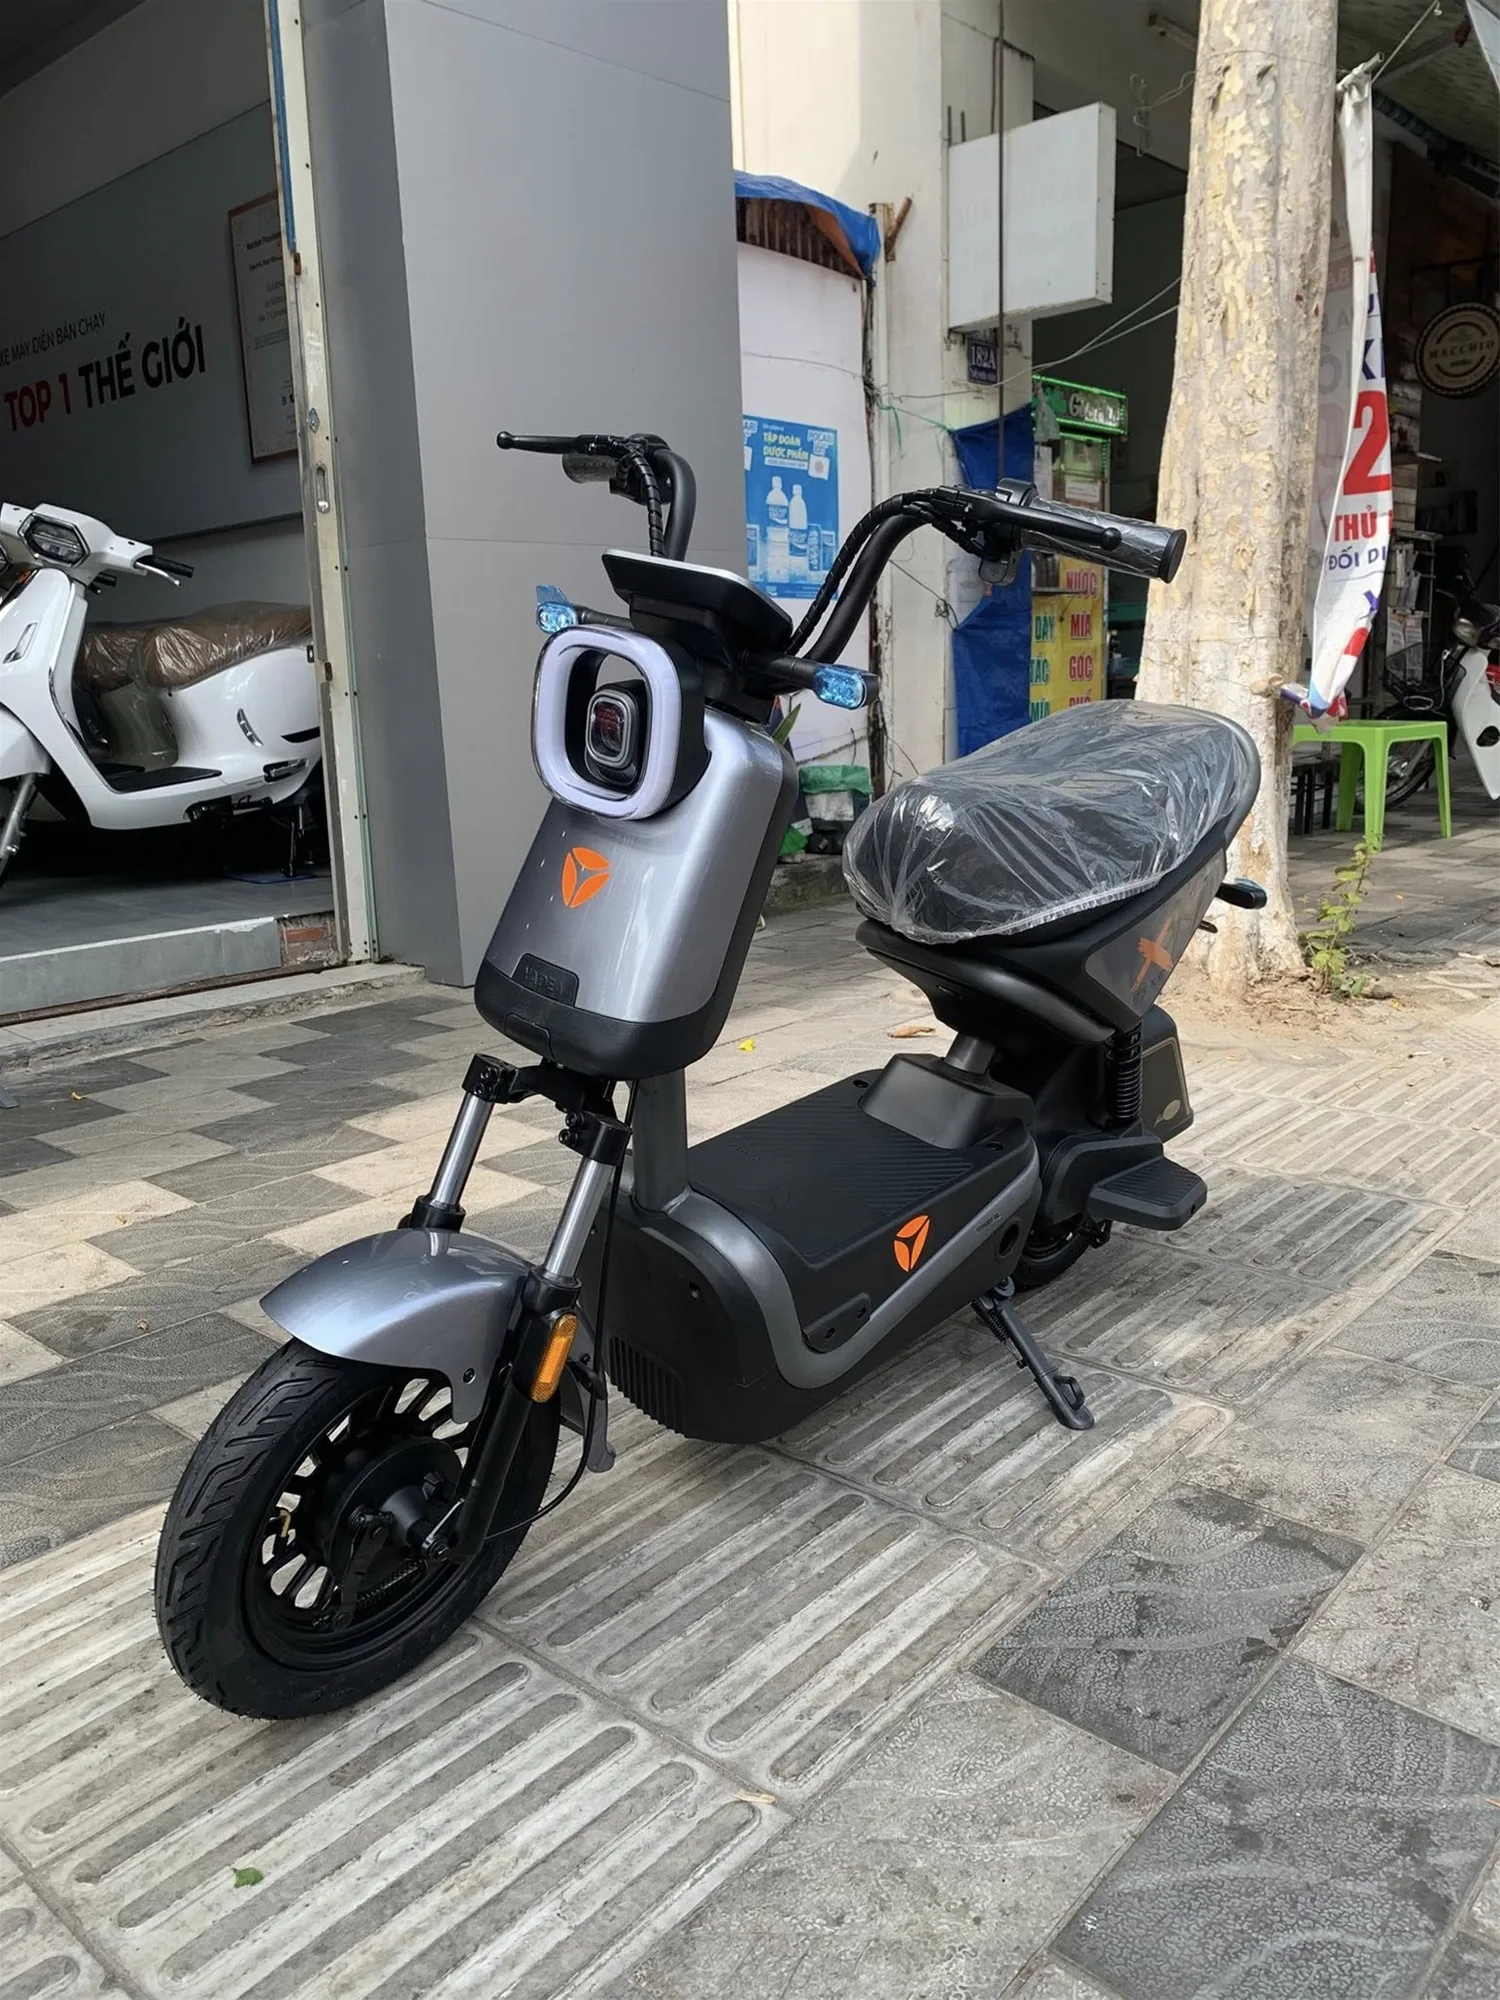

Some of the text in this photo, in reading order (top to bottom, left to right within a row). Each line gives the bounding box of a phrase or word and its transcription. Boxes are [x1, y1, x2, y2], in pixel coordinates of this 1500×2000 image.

[56, 320, 77, 345] BÁN
[78, 311, 106, 336] CHẠY
[4, 316, 206, 431] TOP 1 THẾ GIỚI
[1334, 504, 1377, 542] THỦ
[1328, 546, 1360, 571] ĐỐI
